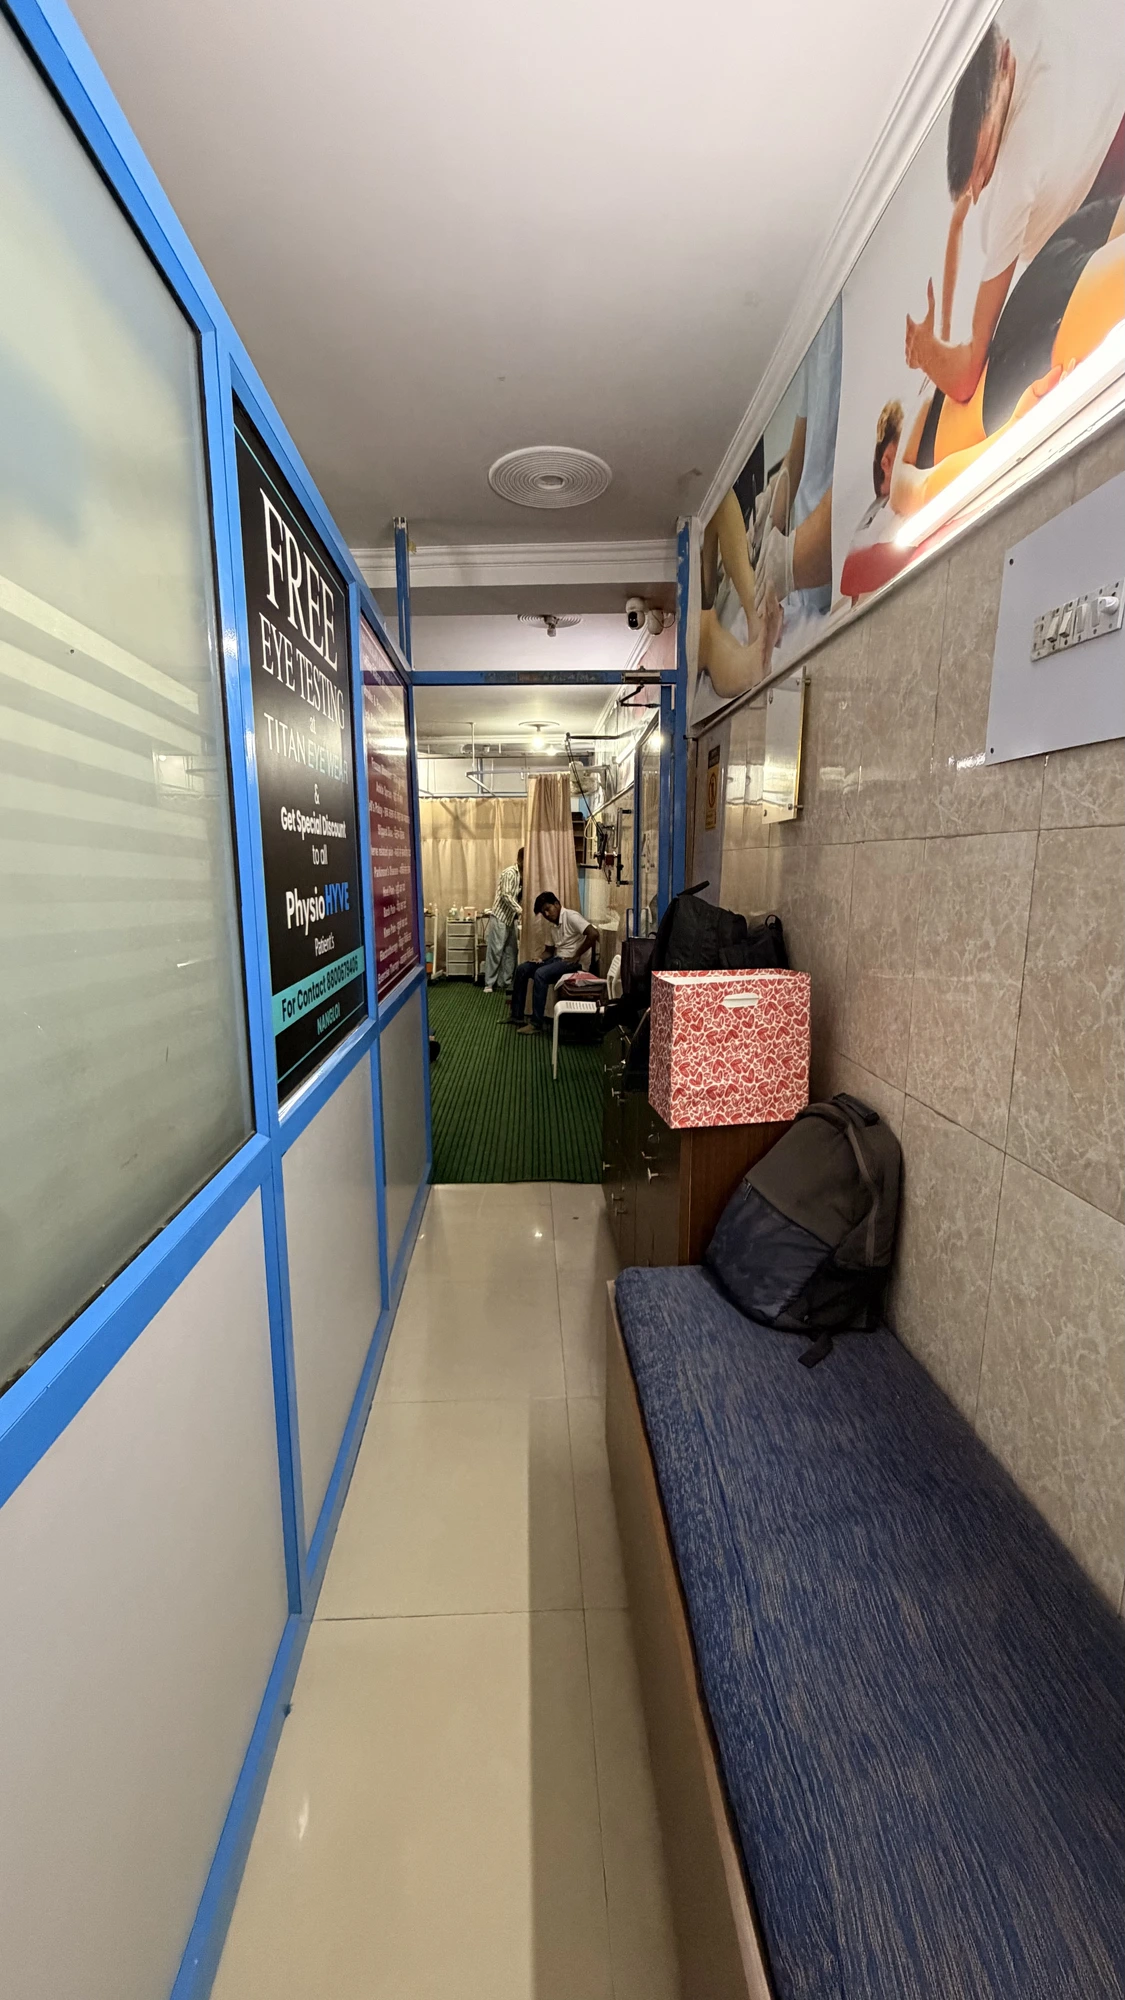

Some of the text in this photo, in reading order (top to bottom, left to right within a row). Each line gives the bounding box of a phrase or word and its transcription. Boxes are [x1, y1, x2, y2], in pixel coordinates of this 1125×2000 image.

[259, 487, 339, 672] FREE
[258, 612, 296, 693] EYE
[296, 648, 345, 730] TESTING
[263, 712, 307, 766] TITAN
[309, 716, 317, 735] at
[314, 783, 321, 805] &
[280, 806, 347, 841] Get Special Discount
[312, 844, 328, 865] to all
[285, 881, 350, 937] PhysioHYVE
[281, 995, 297, 1023] For
[297, 974, 327, 1011] Contact
